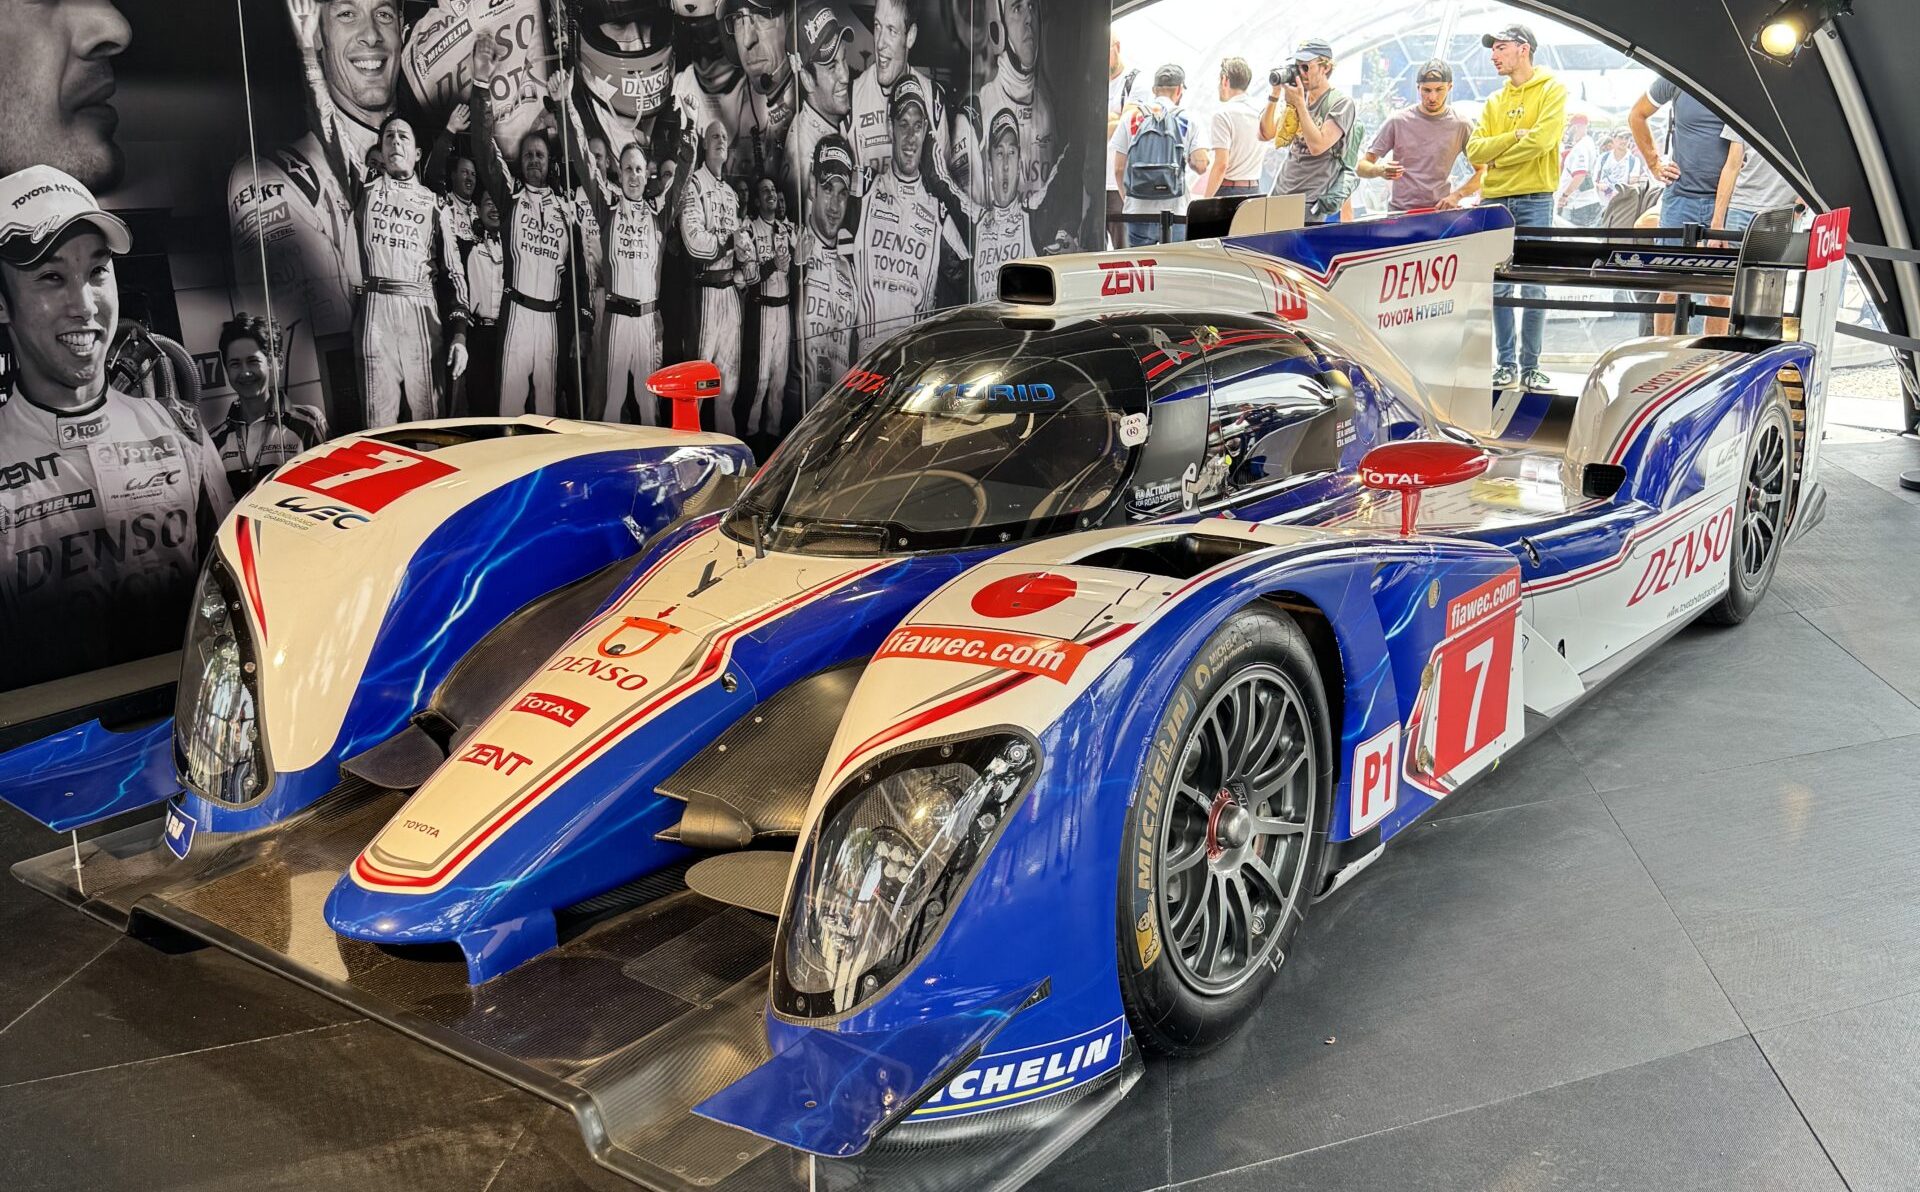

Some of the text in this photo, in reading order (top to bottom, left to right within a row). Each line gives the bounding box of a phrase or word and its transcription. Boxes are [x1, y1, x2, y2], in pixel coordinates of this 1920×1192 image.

[417, 15, 455, 45] ZENT
[427, 21, 470, 64] MICHELIN
[860, 111, 884, 128] ZENT
[12, 185, 53, 210] TOYOTA
[371, 201, 425, 225] DENSO
[520, 213, 565, 239] DENSO
[371, 232, 418, 251] HYBRID
[372, 216, 420, 240] TOYOTA
[521, 228, 560, 251] TOYOTA
[520, 242, 559, 261] HYBRID
[872, 229, 927, 260] DENSO
[978, 242, 1021, 269] DENSO
[874, 255, 919, 280] TOYOTA
[1649, 256, 1739, 268] MICHEL
[1098, 258, 1157, 297] ZENT
[1379, 253, 1458, 304] DENSO
[806, 296, 852, 328] DENSO
[1378, 300, 1454, 330] TOYOTA HYBRID
[1630, 367, 1683, 394] TOYOTA
[121, 442, 176, 461] TOTAL
[126, 469, 181, 491] WEC
[309, 450, 423, 490] 7
[1361, 467, 1425, 485] TOTAL
[1144, 496, 1160, 507] ROAD
[1159, 490, 1181, 502] SAFETY
[1145, 483, 1170, 498] ACTION
[14, 493, 91, 523] MICHELIN
[263, 514, 309, 531] CHAMPIONSHIP
[274, 496, 371, 530] WEC
[16, 509, 188, 594] DENSO
[1627, 506, 1733, 607] DENSO
[1451, 577, 1516, 630] fiawec.com
[882, 630, 1067, 672] fiawec.com
[547, 656, 648, 691] DENSO
[521, 694, 575, 722] TOTAL
[1464, 637, 1494, 753] 7
[457, 743, 533, 776] ZENT
[1137, 689, 1190, 890] MICHELIN
[1361, 742, 1393, 817] P1
[402, 819, 440, 838] TOYOTA
[928, 1033, 1113, 1102] ICHELIN
